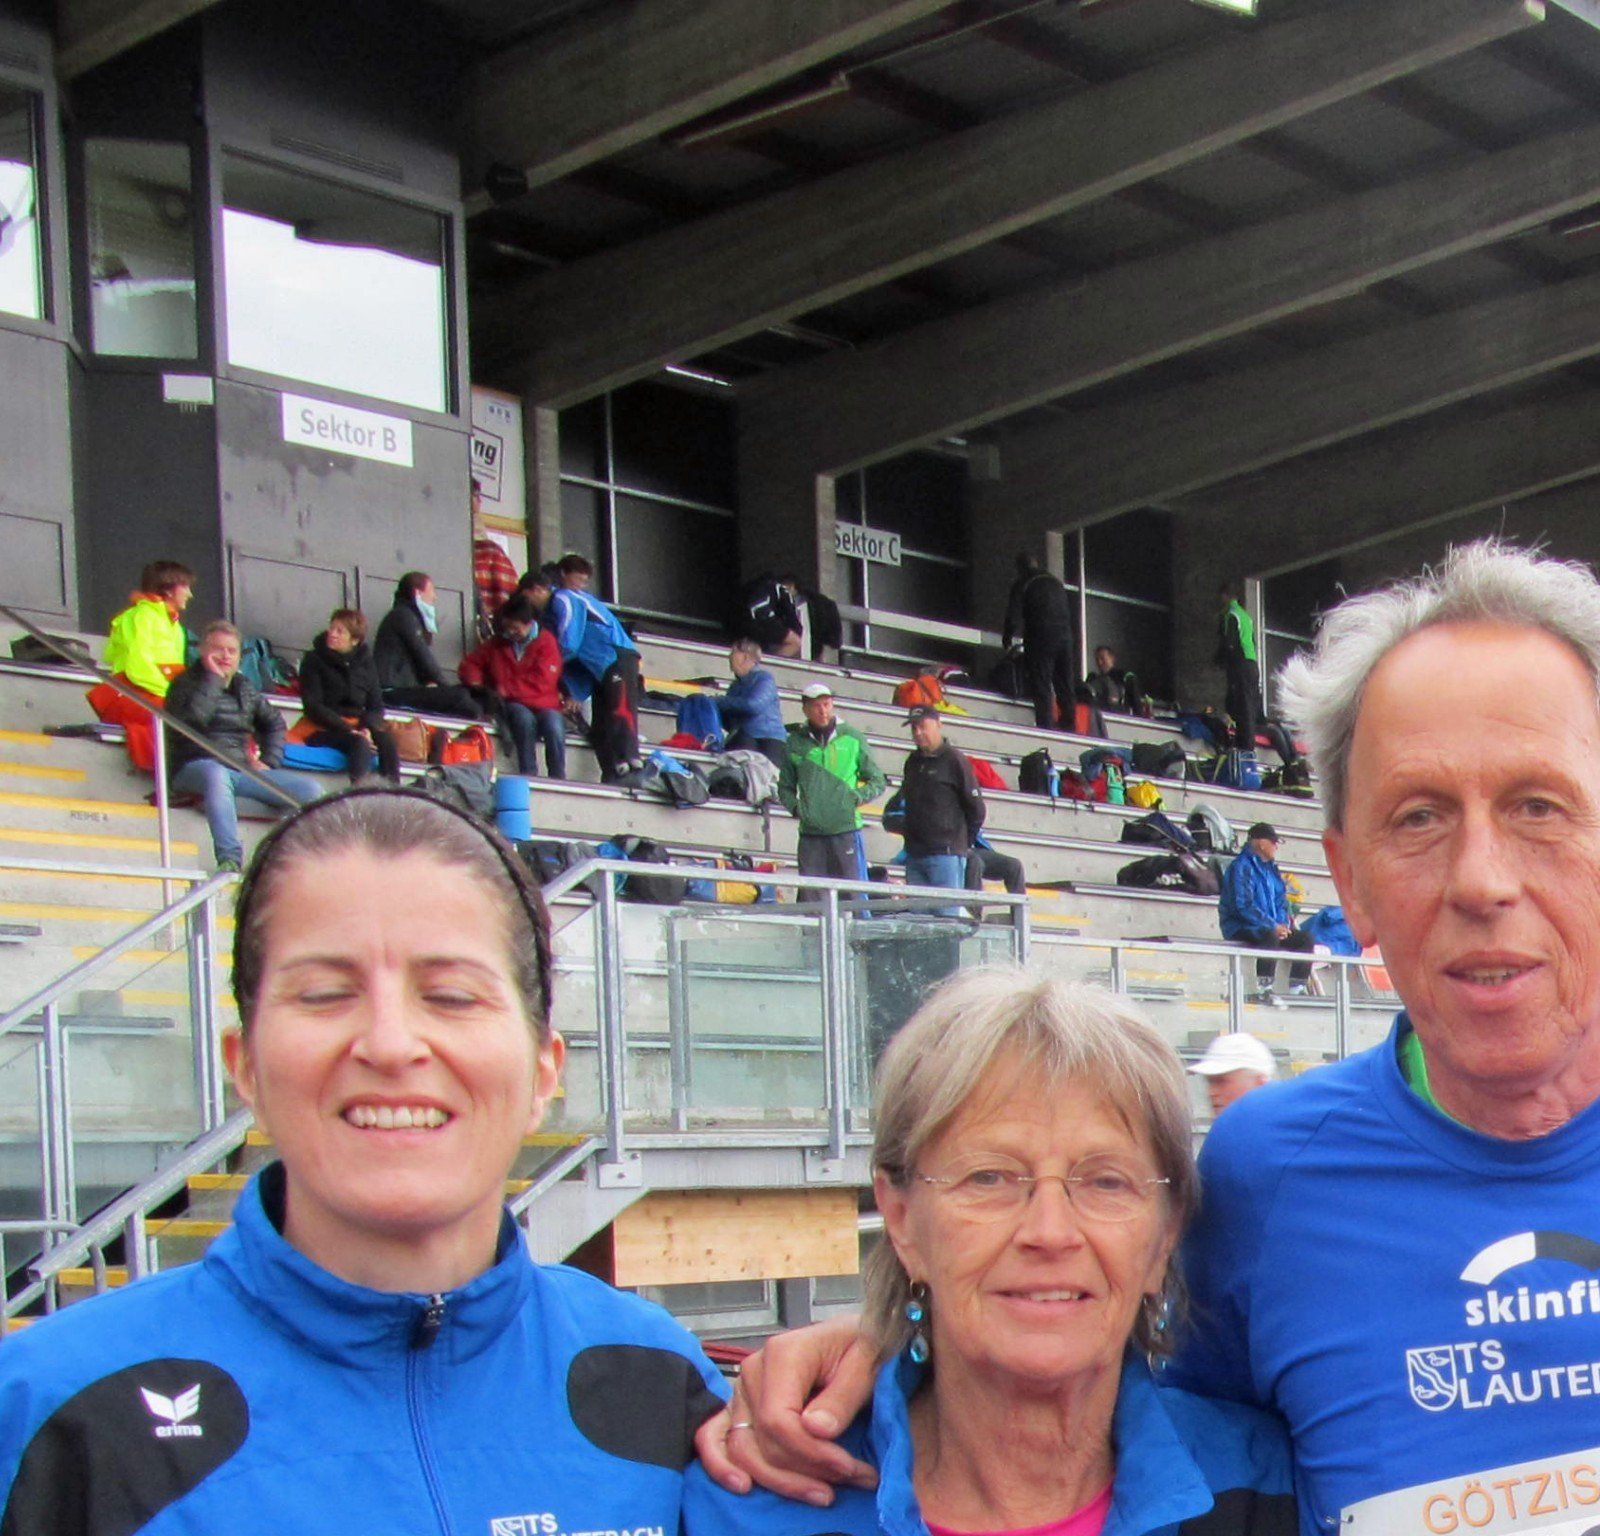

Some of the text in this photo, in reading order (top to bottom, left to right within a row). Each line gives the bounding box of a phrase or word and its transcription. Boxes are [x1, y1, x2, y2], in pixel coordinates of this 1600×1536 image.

[300, 408, 397, 452] Sektor B
[473, 440, 497, 466] ng
[889, 537, 898, 562] C
[1454, 1339, 1506, 1374] TS
[524, 1513, 558, 1535] TS
